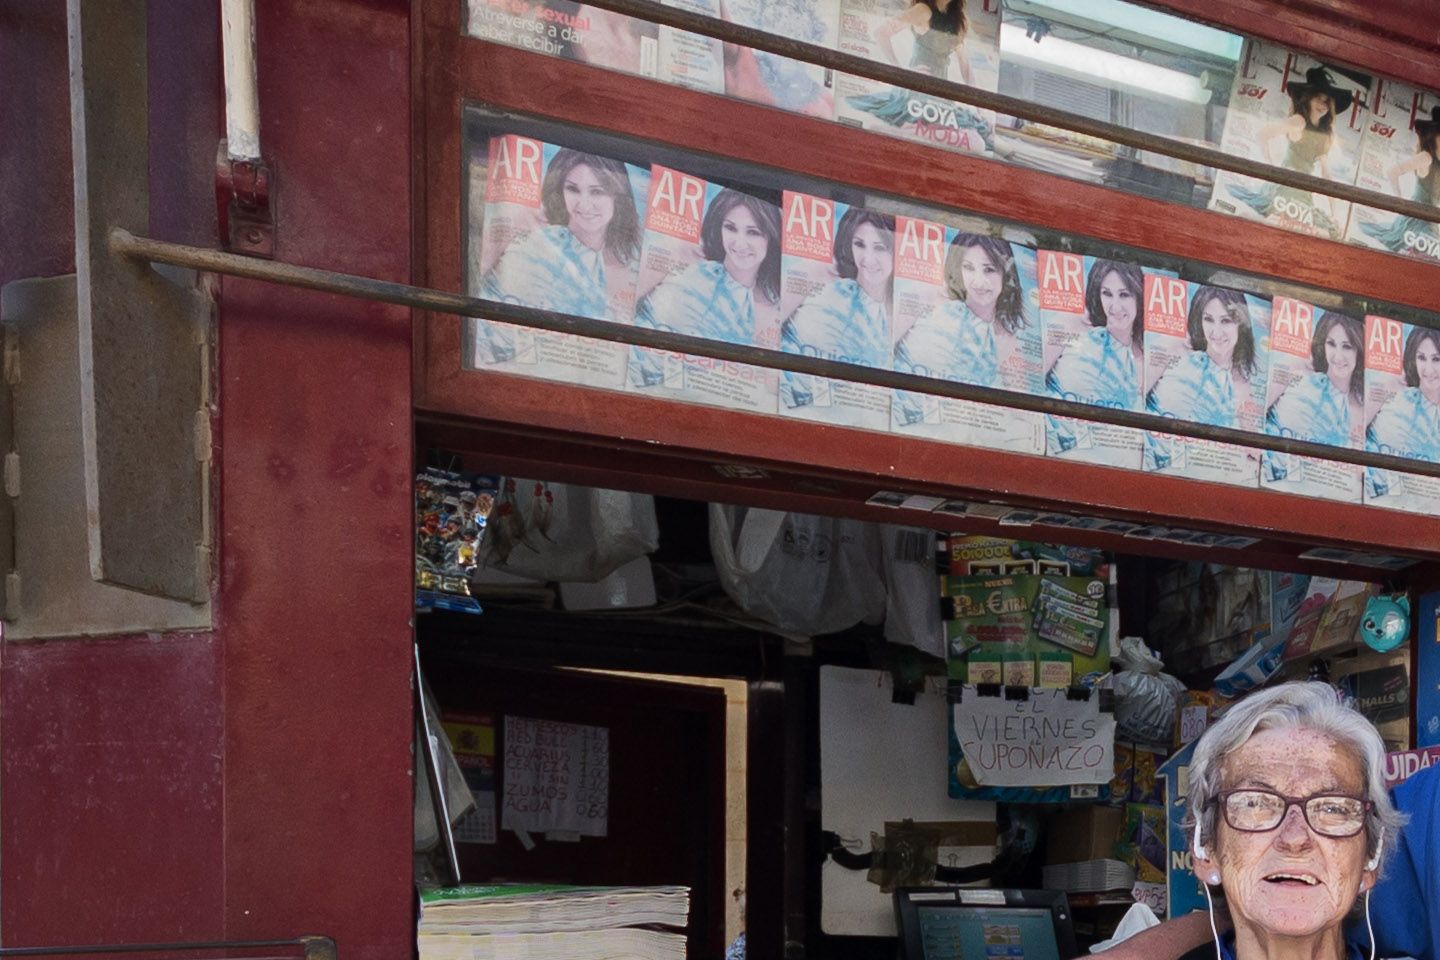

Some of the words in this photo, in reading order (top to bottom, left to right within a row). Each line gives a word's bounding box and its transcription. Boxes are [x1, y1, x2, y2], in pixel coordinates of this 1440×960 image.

[473, 6, 544, 34] Atreverse
[547, 25, 558, 38] a
[517, 33, 565, 56] recibir
[907, 101, 959, 128] GOYA
[914, 121, 972, 150] MODA
[491, 137, 540, 184] AR
[652, 170, 703, 220] AR
[1273, 195, 1314, 226] GOYA
[785, 194, 832, 241] AR
[899, 218, 943, 266] AR
[1042, 253, 1083, 293] AR
[1148, 277, 1186, 317] AR
[1274, 300, 1312, 340] AR
[1368, 319, 1402, 356] AR
[416, 473, 472, 488] playmobil
[1361, 693, 1396, 708] HALLS
[971, 714, 1097, 741] VIERNES
[506, 783, 568, 801] ZUMOS
[506, 795, 552, 814] AGUA
